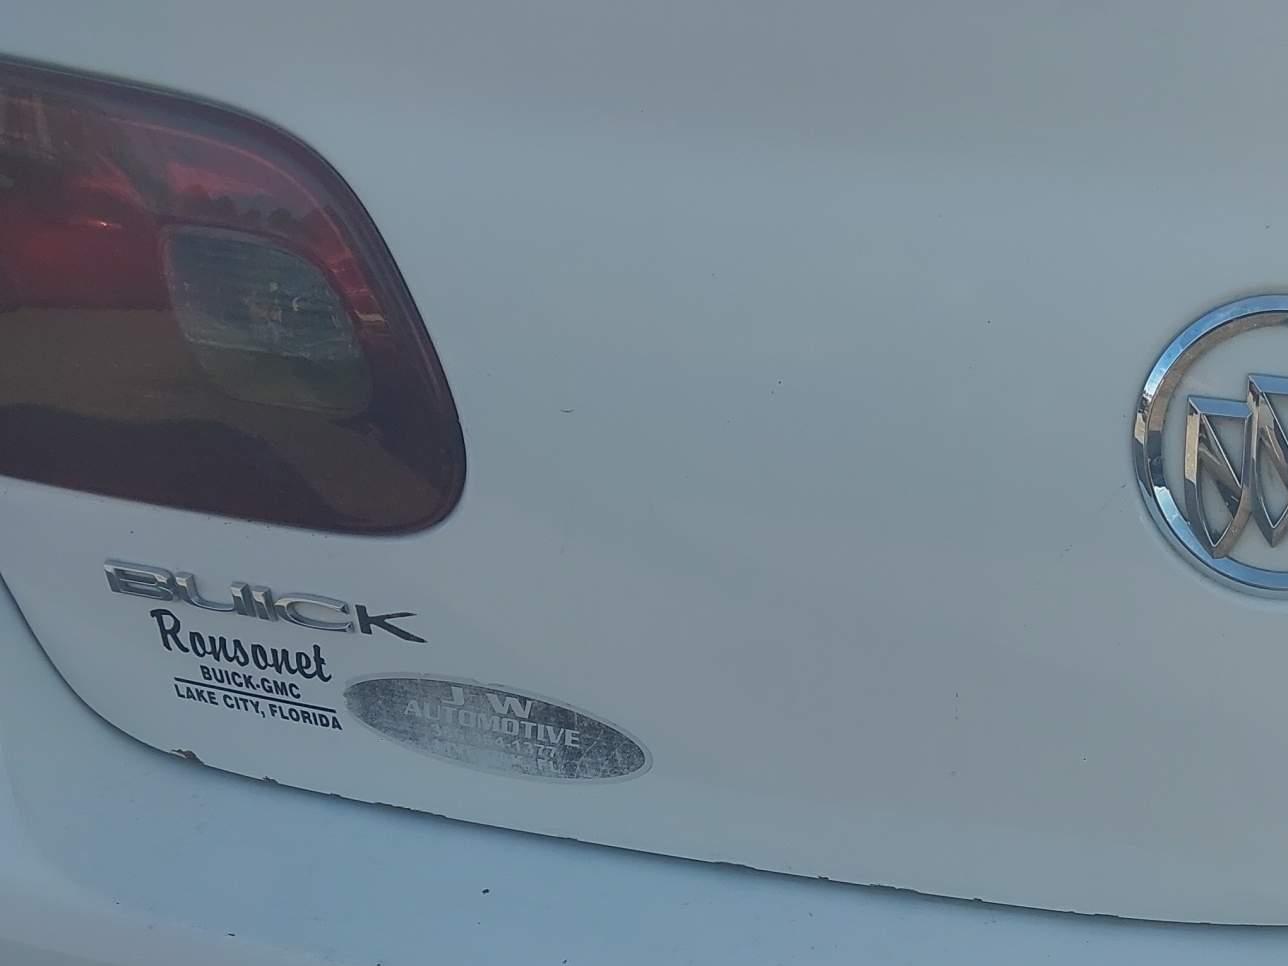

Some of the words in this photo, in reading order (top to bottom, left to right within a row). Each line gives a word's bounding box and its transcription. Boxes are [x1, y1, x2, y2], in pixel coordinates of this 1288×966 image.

[104, 559, 427, 643] BUICK
[150, 608, 332, 682] Ronsonet
[200, 665, 301, 699] BUICK-GMC
[174, 683, 218, 706] LAKE
[222, 693, 266, 718] CITY,
[269, 704, 343, 730] FLORIDA
[404, 700, 581, 748] AUTOMOTIVE
[485, 693, 534, 719] W
